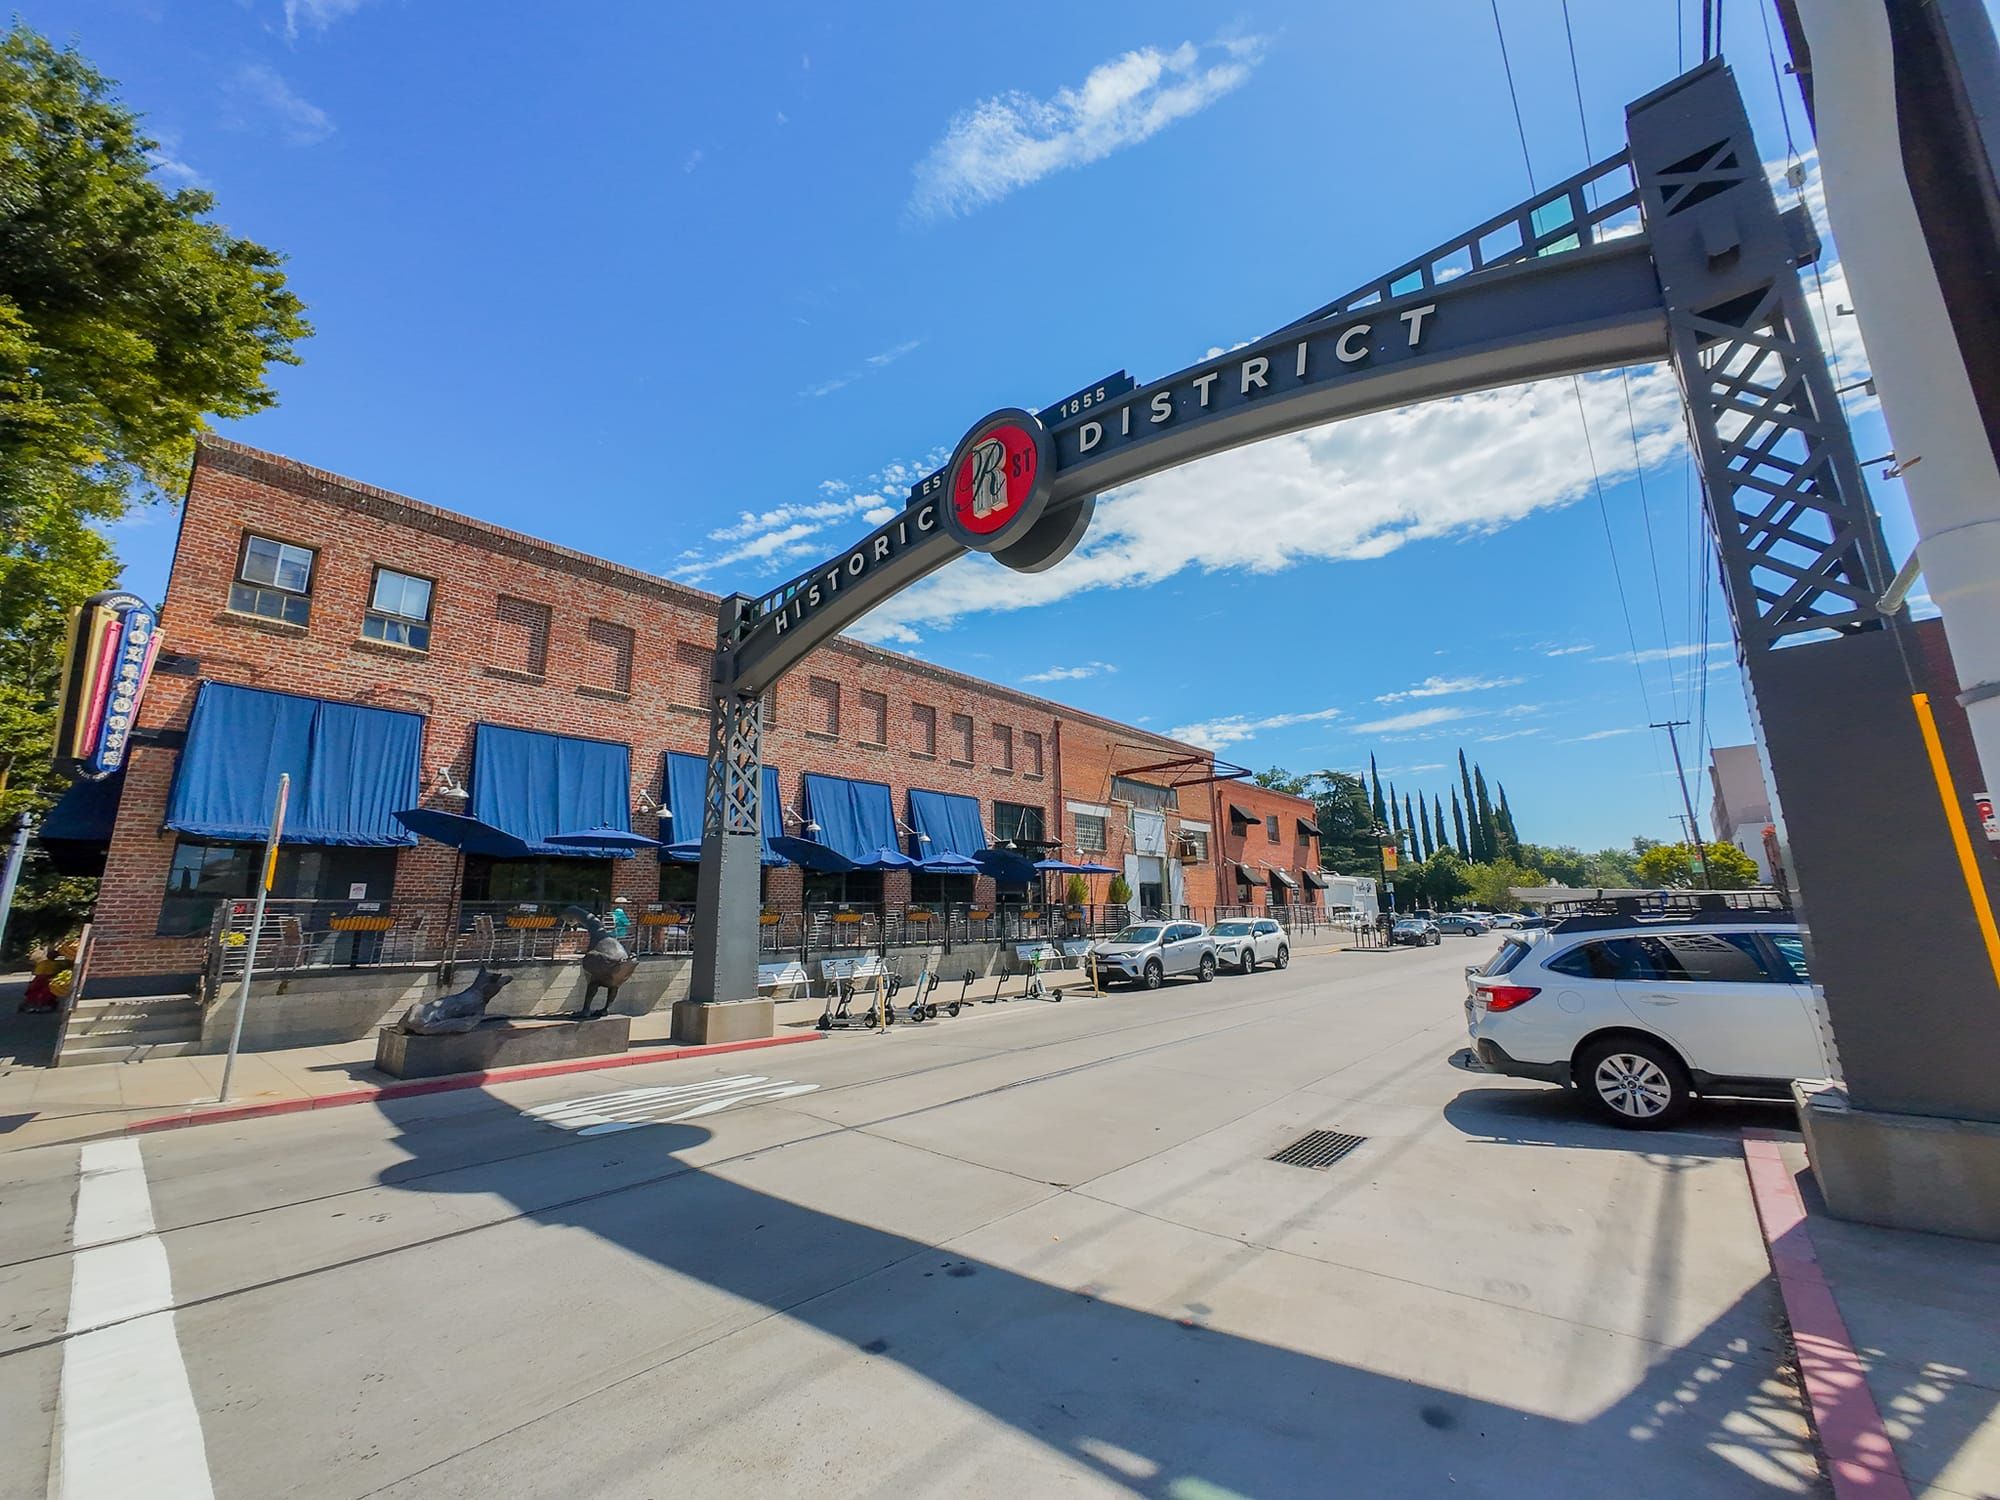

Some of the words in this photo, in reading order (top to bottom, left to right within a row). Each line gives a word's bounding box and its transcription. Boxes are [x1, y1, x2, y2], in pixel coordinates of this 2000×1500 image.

[775, 506, 935, 634] HISTORIC
[1079, 304, 1436, 453] DISTRICT
[922, 470, 947, 496] ES
[1060, 387, 1105, 418] 1855
[1012, 448, 1031, 478] ST
[519, 1073, 821, 1137] STOP
